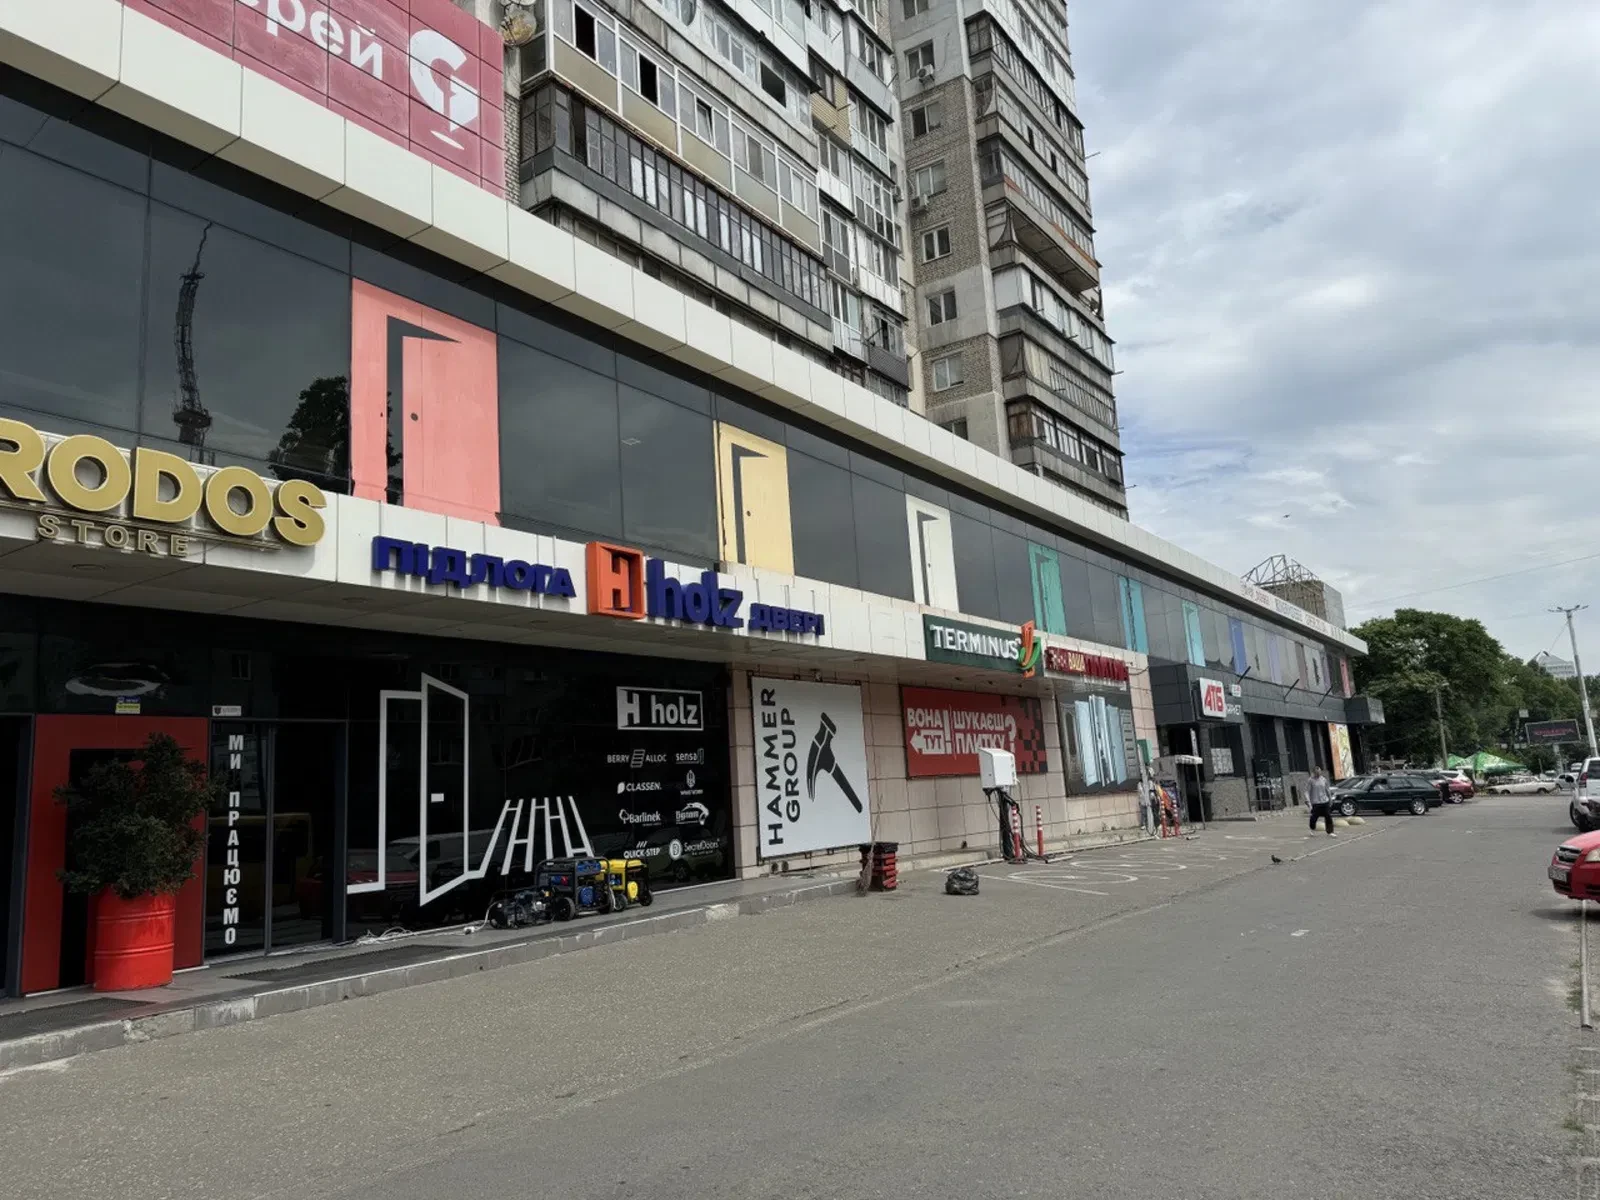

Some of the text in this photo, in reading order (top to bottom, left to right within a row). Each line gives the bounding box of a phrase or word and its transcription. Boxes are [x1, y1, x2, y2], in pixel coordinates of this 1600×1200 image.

[243, 0, 384, 80] рей
[0, 417, 327, 547] RODOS
[37, 514, 190, 558] STORE
[372, 536, 577, 599] ПІДЛОГА
[647, 556, 744, 629] holz
[748, 602, 826, 636] ДВЕРІ
[929, 623, 1020, 660] TERMINUS
[651, 694, 698, 725] holz
[907, 708, 943, 728] ВОНА
[953, 710, 1005, 731] ШУКАЄШ
[228, 735, 244, 769] МИ
[607, 754, 667, 763] BERRY ALLOC
[923, 734, 942, 753] ТУТ
[955, 733, 1005, 754] ПЛИТКУ
[761, 688, 784, 845] HAMMER
[781, 708, 801, 823] GROUP
[629, 811, 662, 824] Barlinek
[223, 791, 241, 944] ПРАЦЮЄМО
